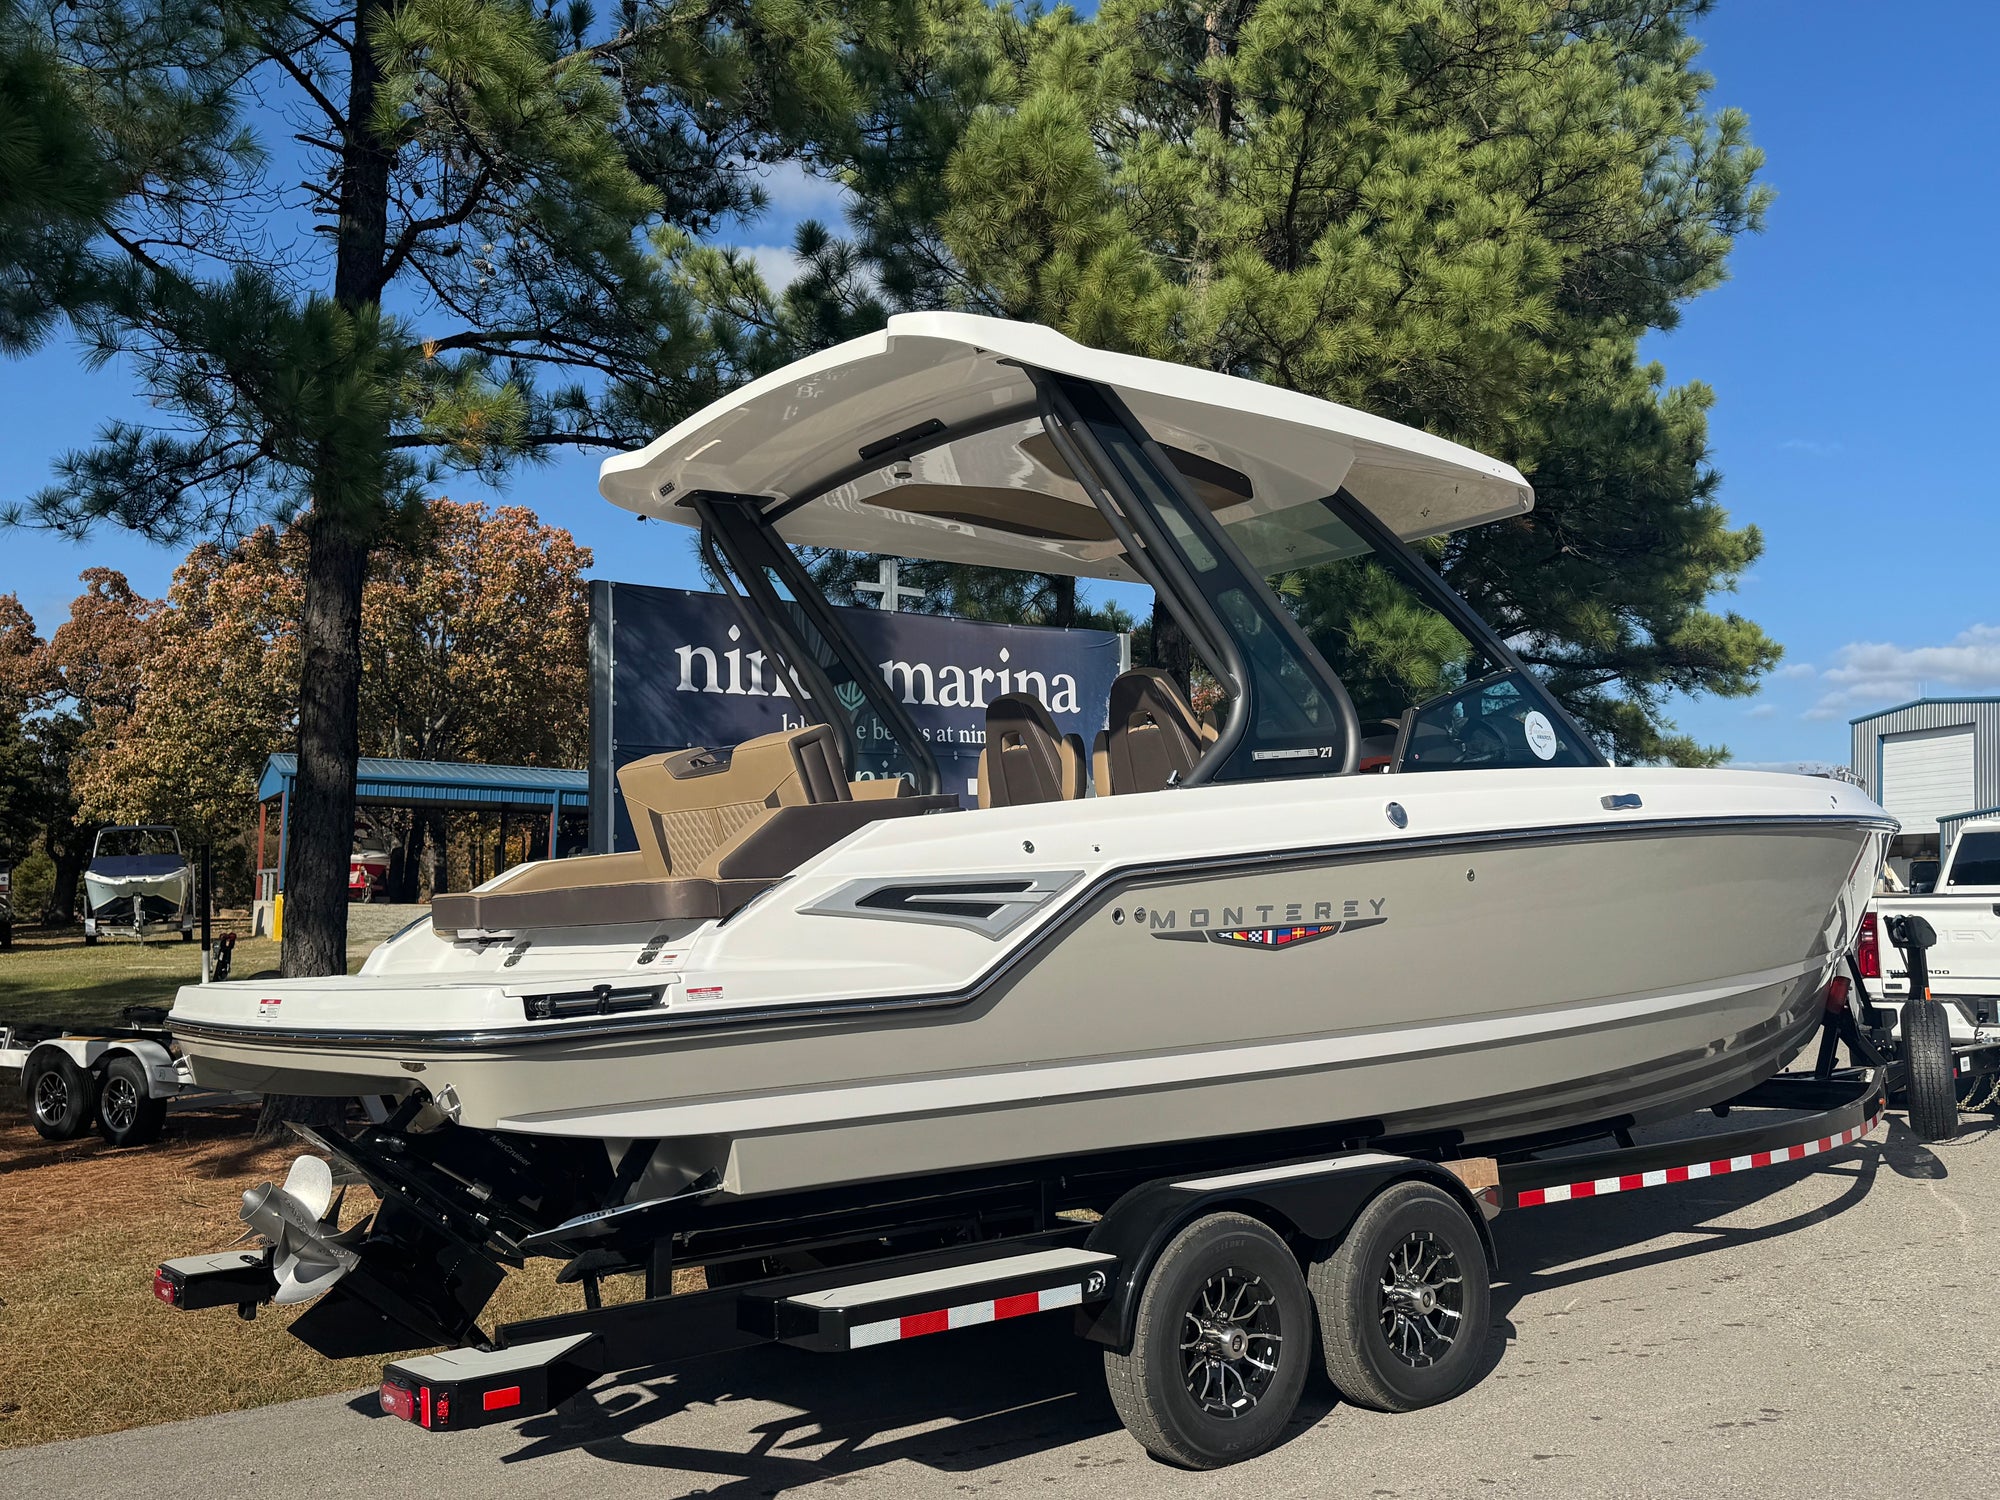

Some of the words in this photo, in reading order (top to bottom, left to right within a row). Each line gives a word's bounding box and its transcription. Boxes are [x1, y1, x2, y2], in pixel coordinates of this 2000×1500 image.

[674, 624, 812, 700] nin
[879, 647, 1081, 714] marina
[936, 725, 954, 742] at
[958, 723, 987, 744] nin
[1257, 749, 1315, 759] ELITE
[1319, 746, 1333, 759] 27
[1150, 897, 1386, 930] MONTEREY
[489, 1135, 532, 1167] MerCruiser
